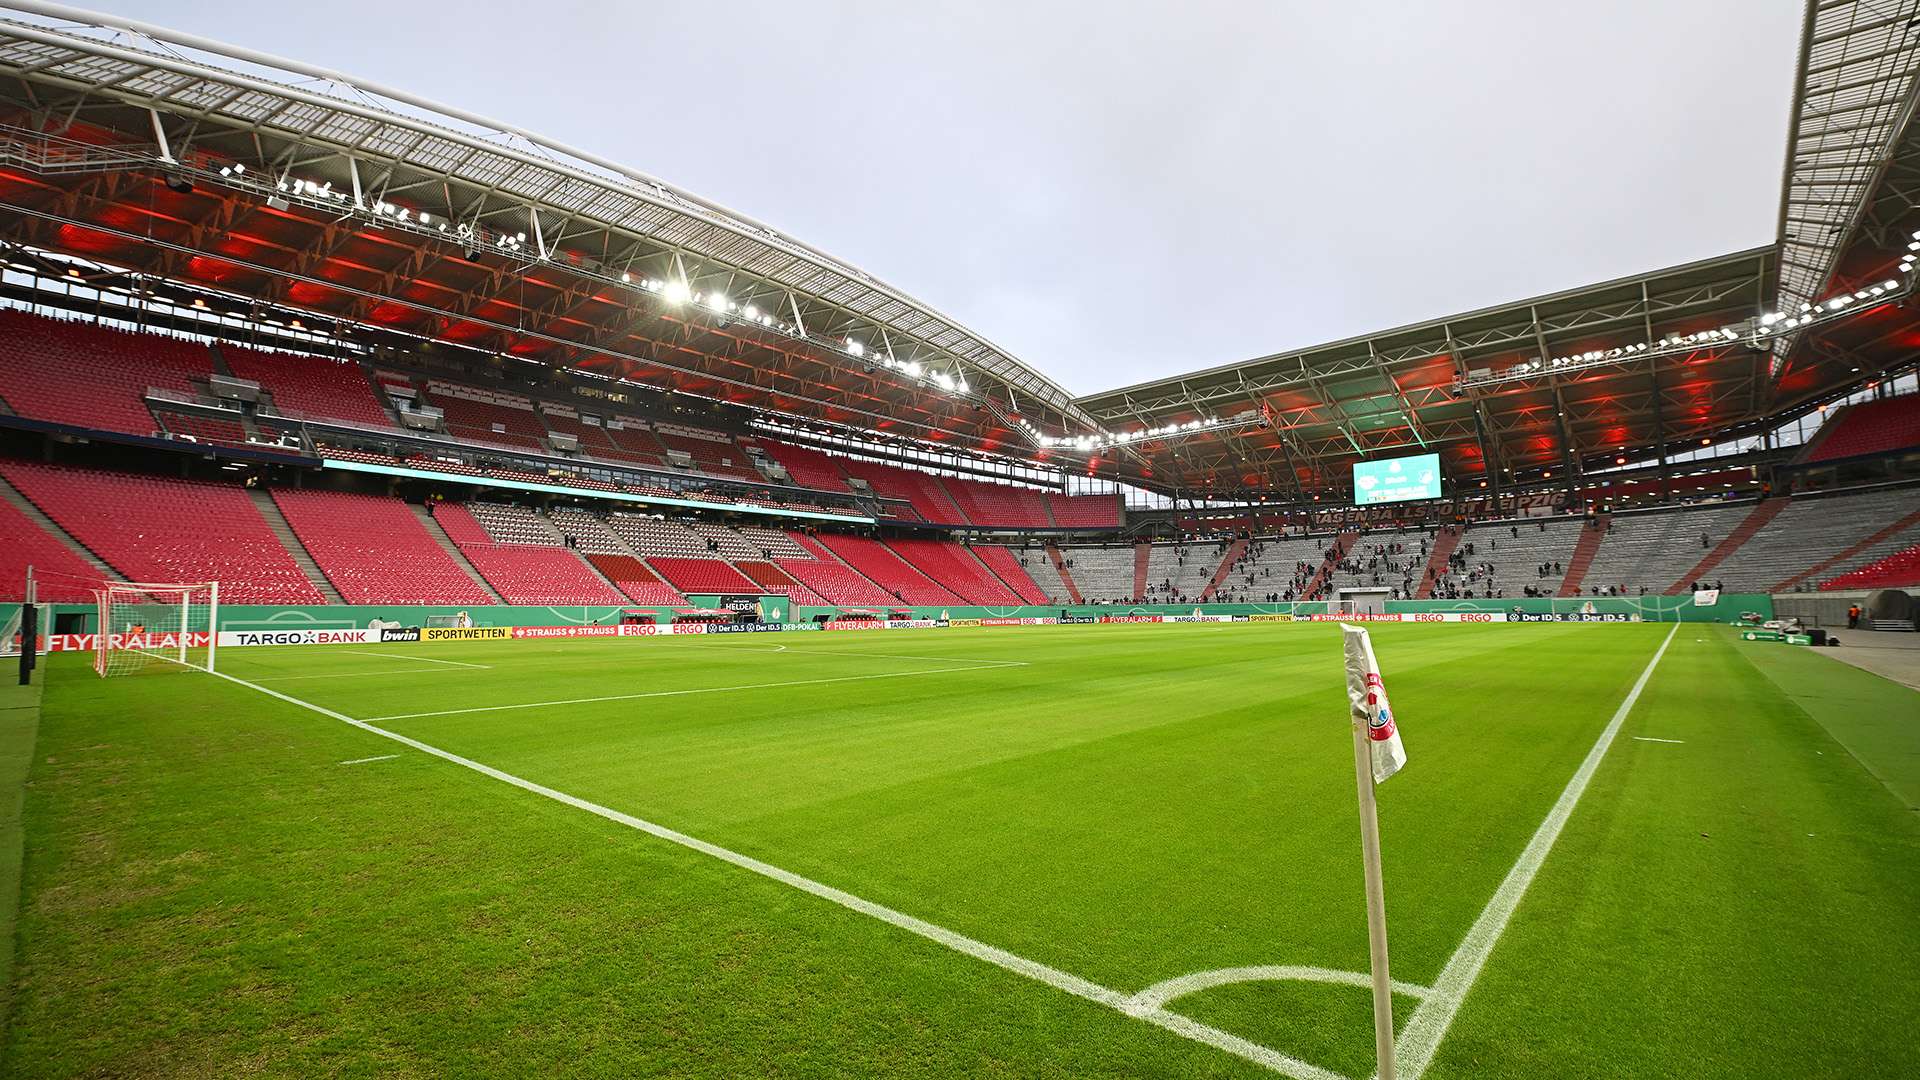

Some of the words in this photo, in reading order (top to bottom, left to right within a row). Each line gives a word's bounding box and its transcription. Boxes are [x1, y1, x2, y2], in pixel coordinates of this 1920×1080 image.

[1485, 492, 1566, 513] LEIPZIG
[1415, 614, 1444, 622] ERGO
[1460, 614, 1491, 622] ERGO
[624, 625, 656, 636] ERGO
[673, 624, 703, 635] ERGO
[835, 620, 883, 630] FLYERALARM
[383, 630, 418, 641] bwin
[428, 629, 505, 639] SPORTWETTEN
[526, 629, 568, 637] STRAUSS
[577, 627, 615, 636] STRAUSS
